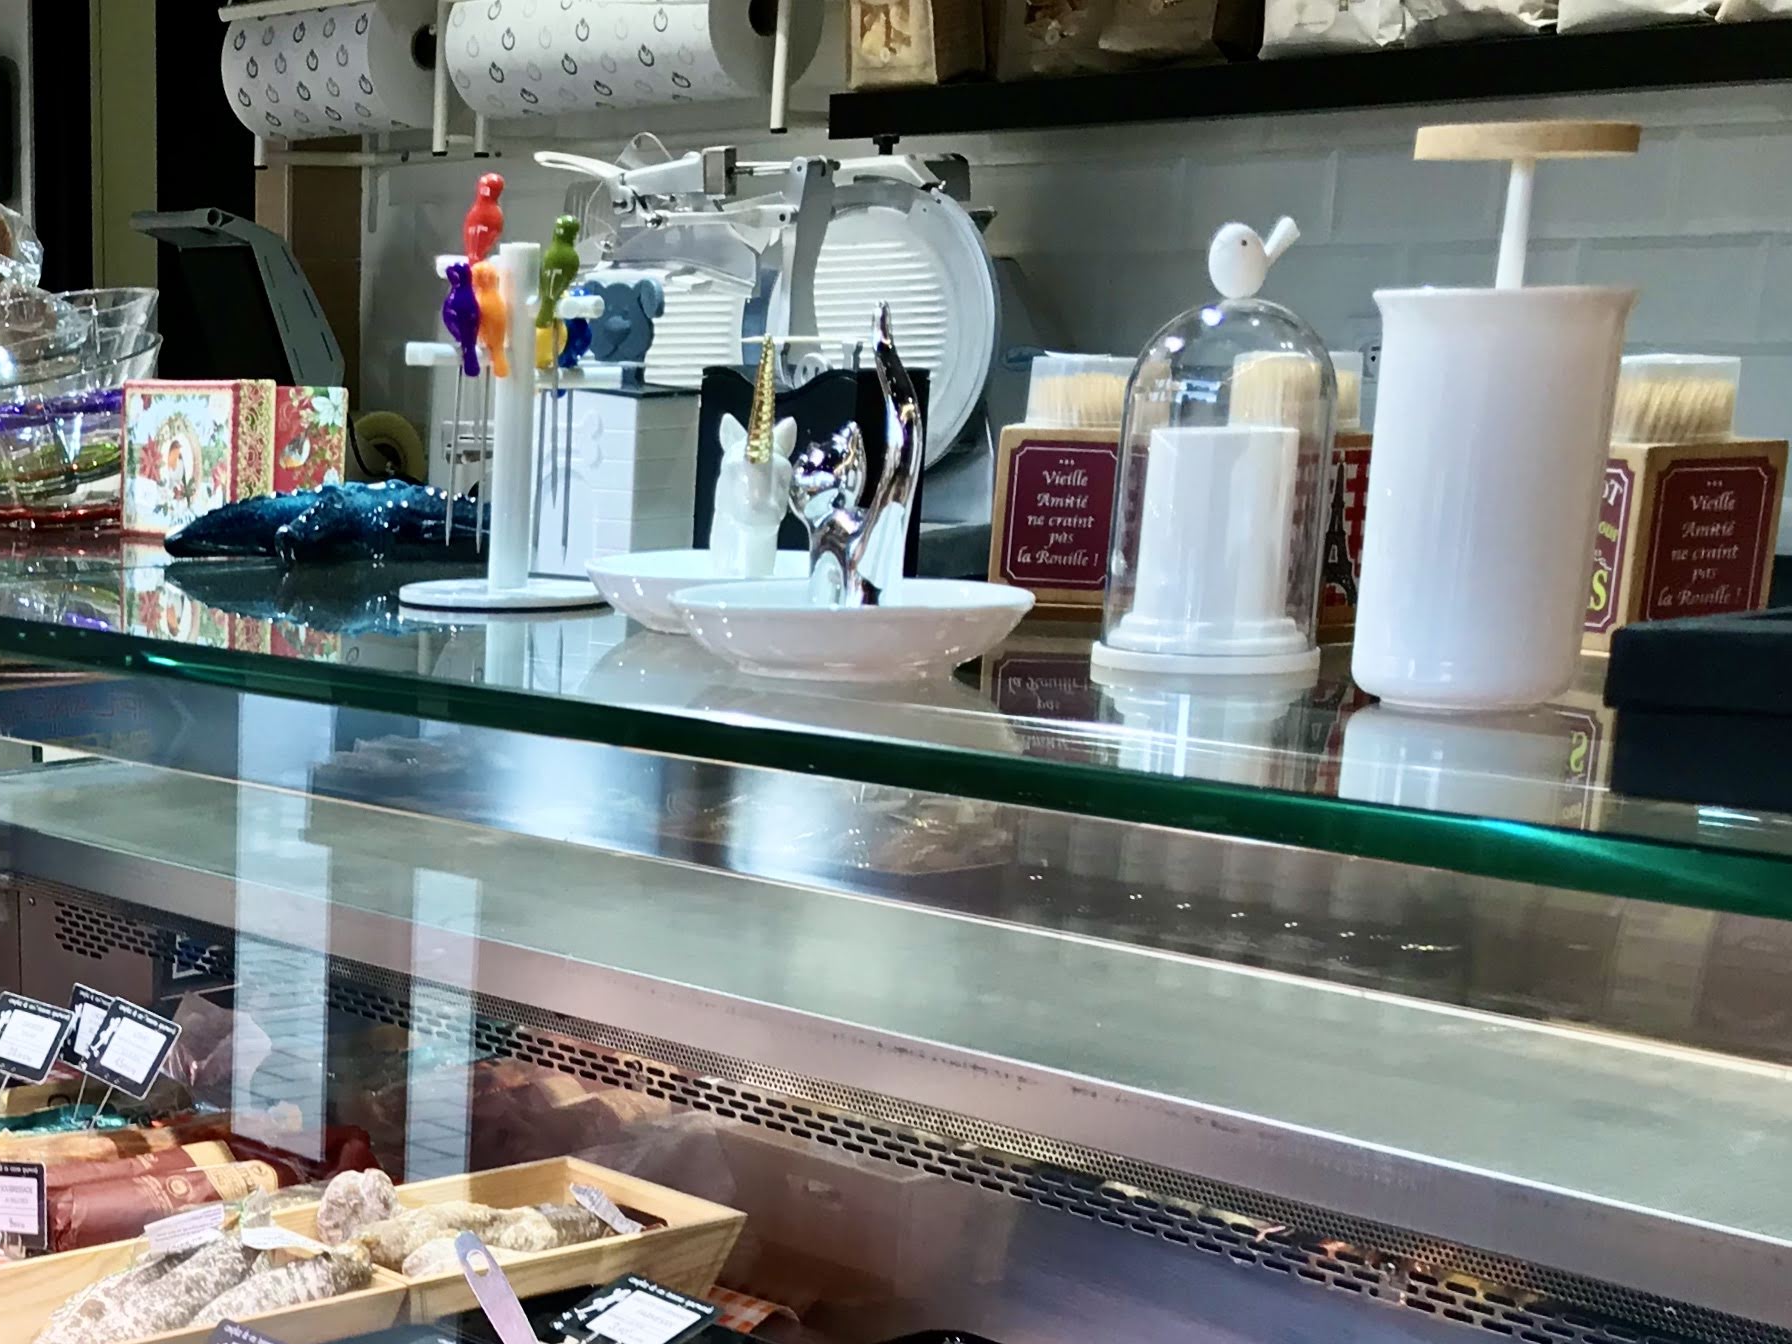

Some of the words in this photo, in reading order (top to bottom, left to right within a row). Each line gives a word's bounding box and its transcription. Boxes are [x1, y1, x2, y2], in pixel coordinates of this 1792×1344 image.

[1042, 469, 1088, 487] Vieille
[1037, 493, 1088, 508] Amitié
[1689, 491, 1737, 511] Vieille
[1027, 515, 1044, 526] ne
[1049, 515, 1095, 528] craint
[1681, 521, 1736, 538] Amitié
[1048, 531, 1074, 547] pas
[1017, 546, 1032, 563] la
[1036, 547, 1089, 566] Rouille
[1671, 549, 1689, 561] ne
[1692, 544, 1739, 561] craint
[1657, 587, 1672, 606] la
[1678, 585, 1734, 606] Rouille
